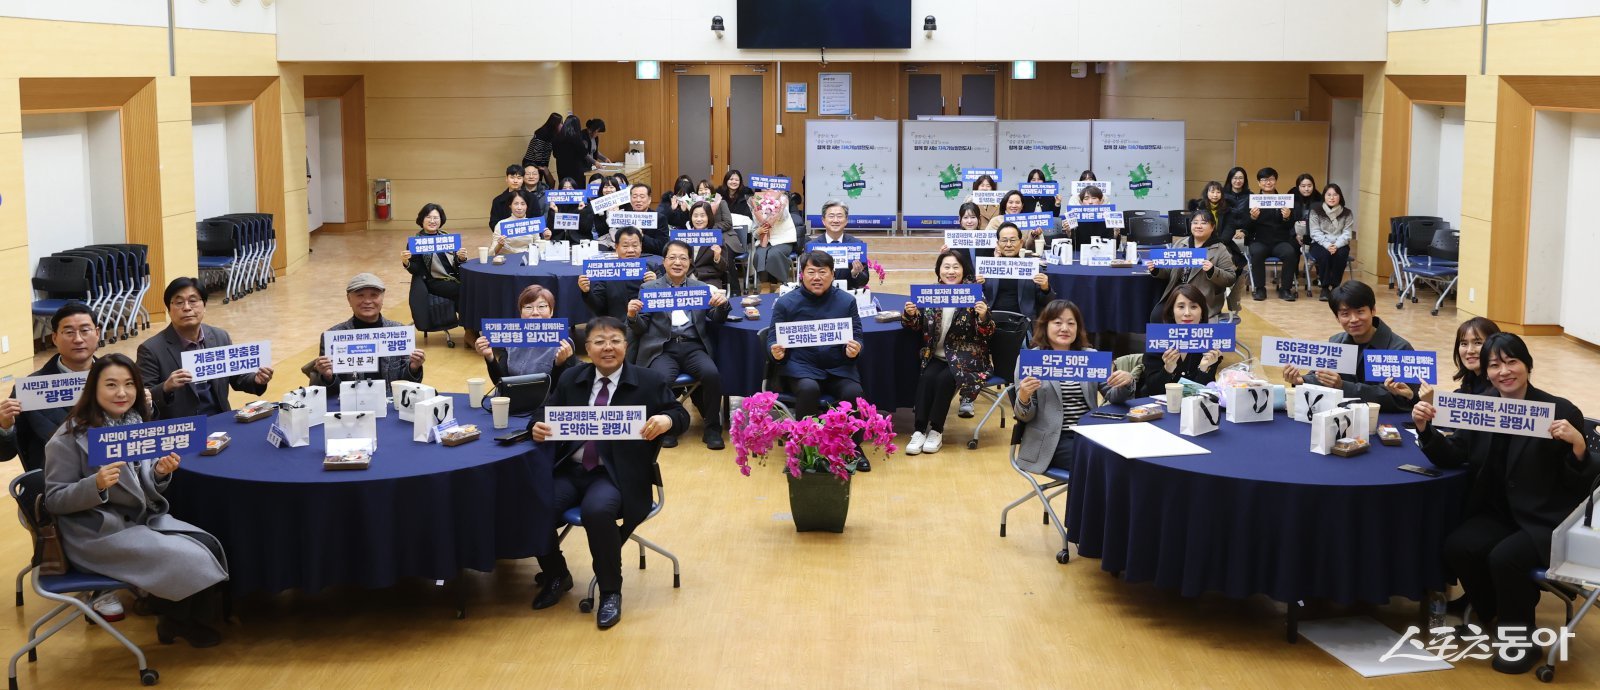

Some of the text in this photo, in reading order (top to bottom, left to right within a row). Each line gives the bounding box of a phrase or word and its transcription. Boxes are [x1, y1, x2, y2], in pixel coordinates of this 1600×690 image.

[586, 269, 620, 278] 일자리도시
[648, 298, 703, 308] 광명형 일자리
[951, 295, 975, 303] 활성화
[818, 323, 835, 331] 시민과
[1169, 328, 1213, 338] 인구 50만
[373, 331, 407, 339] 지속가능한
[490, 332, 559, 343] 광명형 일자리
[788, 332, 841, 344] 도약하는 광명시
[382, 339, 411, 351] "광명"
[1149, 339, 1231, 349] 자족기능도시 광명
[1276, 341, 1343, 357] ESG경영기반
[194, 345, 259, 364] 계층별 맞춤형
[1042, 355, 1089, 366] 인구 50만
[1402, 356, 1415, 364] 시민과
[1417, 356, 1434, 365] 함께하는
[337, 356, 374, 366] 노인분과
[1279, 354, 1337, 369] 일자리 창출
[195, 358, 260, 377] 양질의 일자리
[1022, 366, 1107, 378] 자족기능도시 광명
[1372, 365, 1430, 379] 광명형 일자리
[22, 377, 86, 390] 시민과 함께하는
[37, 387, 84, 403] "광명"
[1438, 396, 1549, 418] 민생경제회복, 시민과 함께
[549, 410, 642, 421] 민생경제회복, 시민과 함께
[1450, 410, 1534, 431] 도약하는 광명시
[99, 422, 196, 443] 시민이 주인공인 일자리,
[560, 422, 630, 435] 도약하는 광명시
[106, 434, 189, 458] 더 밝은 광명
